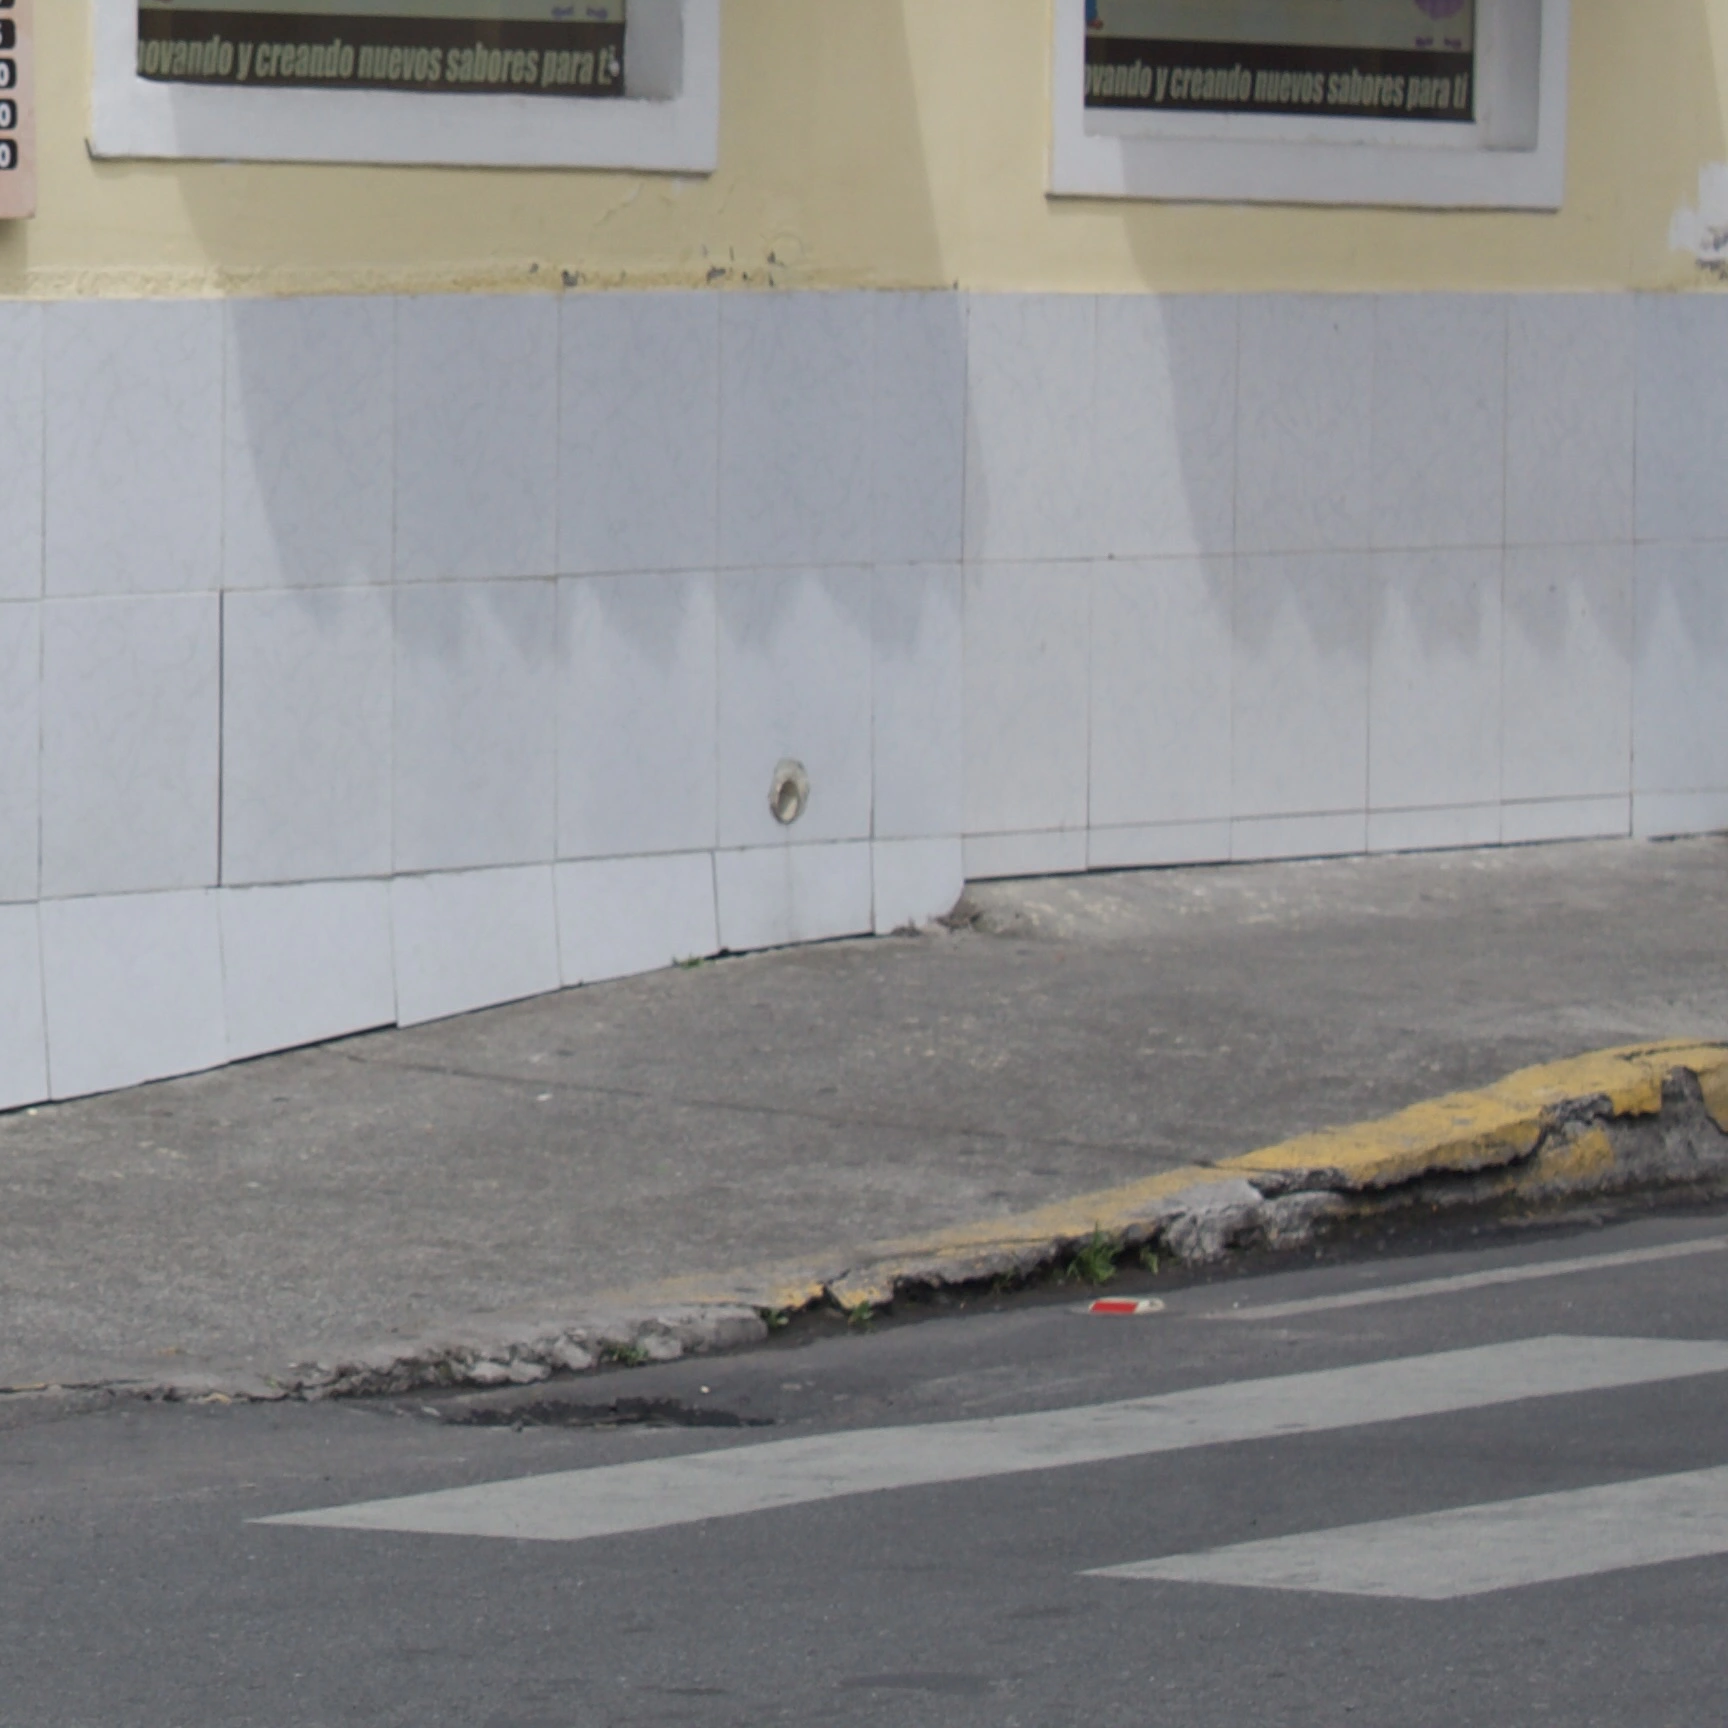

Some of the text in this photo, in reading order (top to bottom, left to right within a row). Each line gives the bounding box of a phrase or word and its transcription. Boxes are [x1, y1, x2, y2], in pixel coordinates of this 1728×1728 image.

[138, 34, 234, 76] ovando
[236, 40, 253, 80] y
[256, 37, 353, 79] creando
[359, 43, 442, 81] nuevos
[446, 42, 538, 85] sabores
[541, 49, 597, 87] para
[1155, 66, 1166, 102] y
[1170, 63, 1253, 104] creando
[1255, 69, 1324, 105] nuevos
[1328, 68, 1405, 108] sabores
[1407, 74, 1450, 110] para
